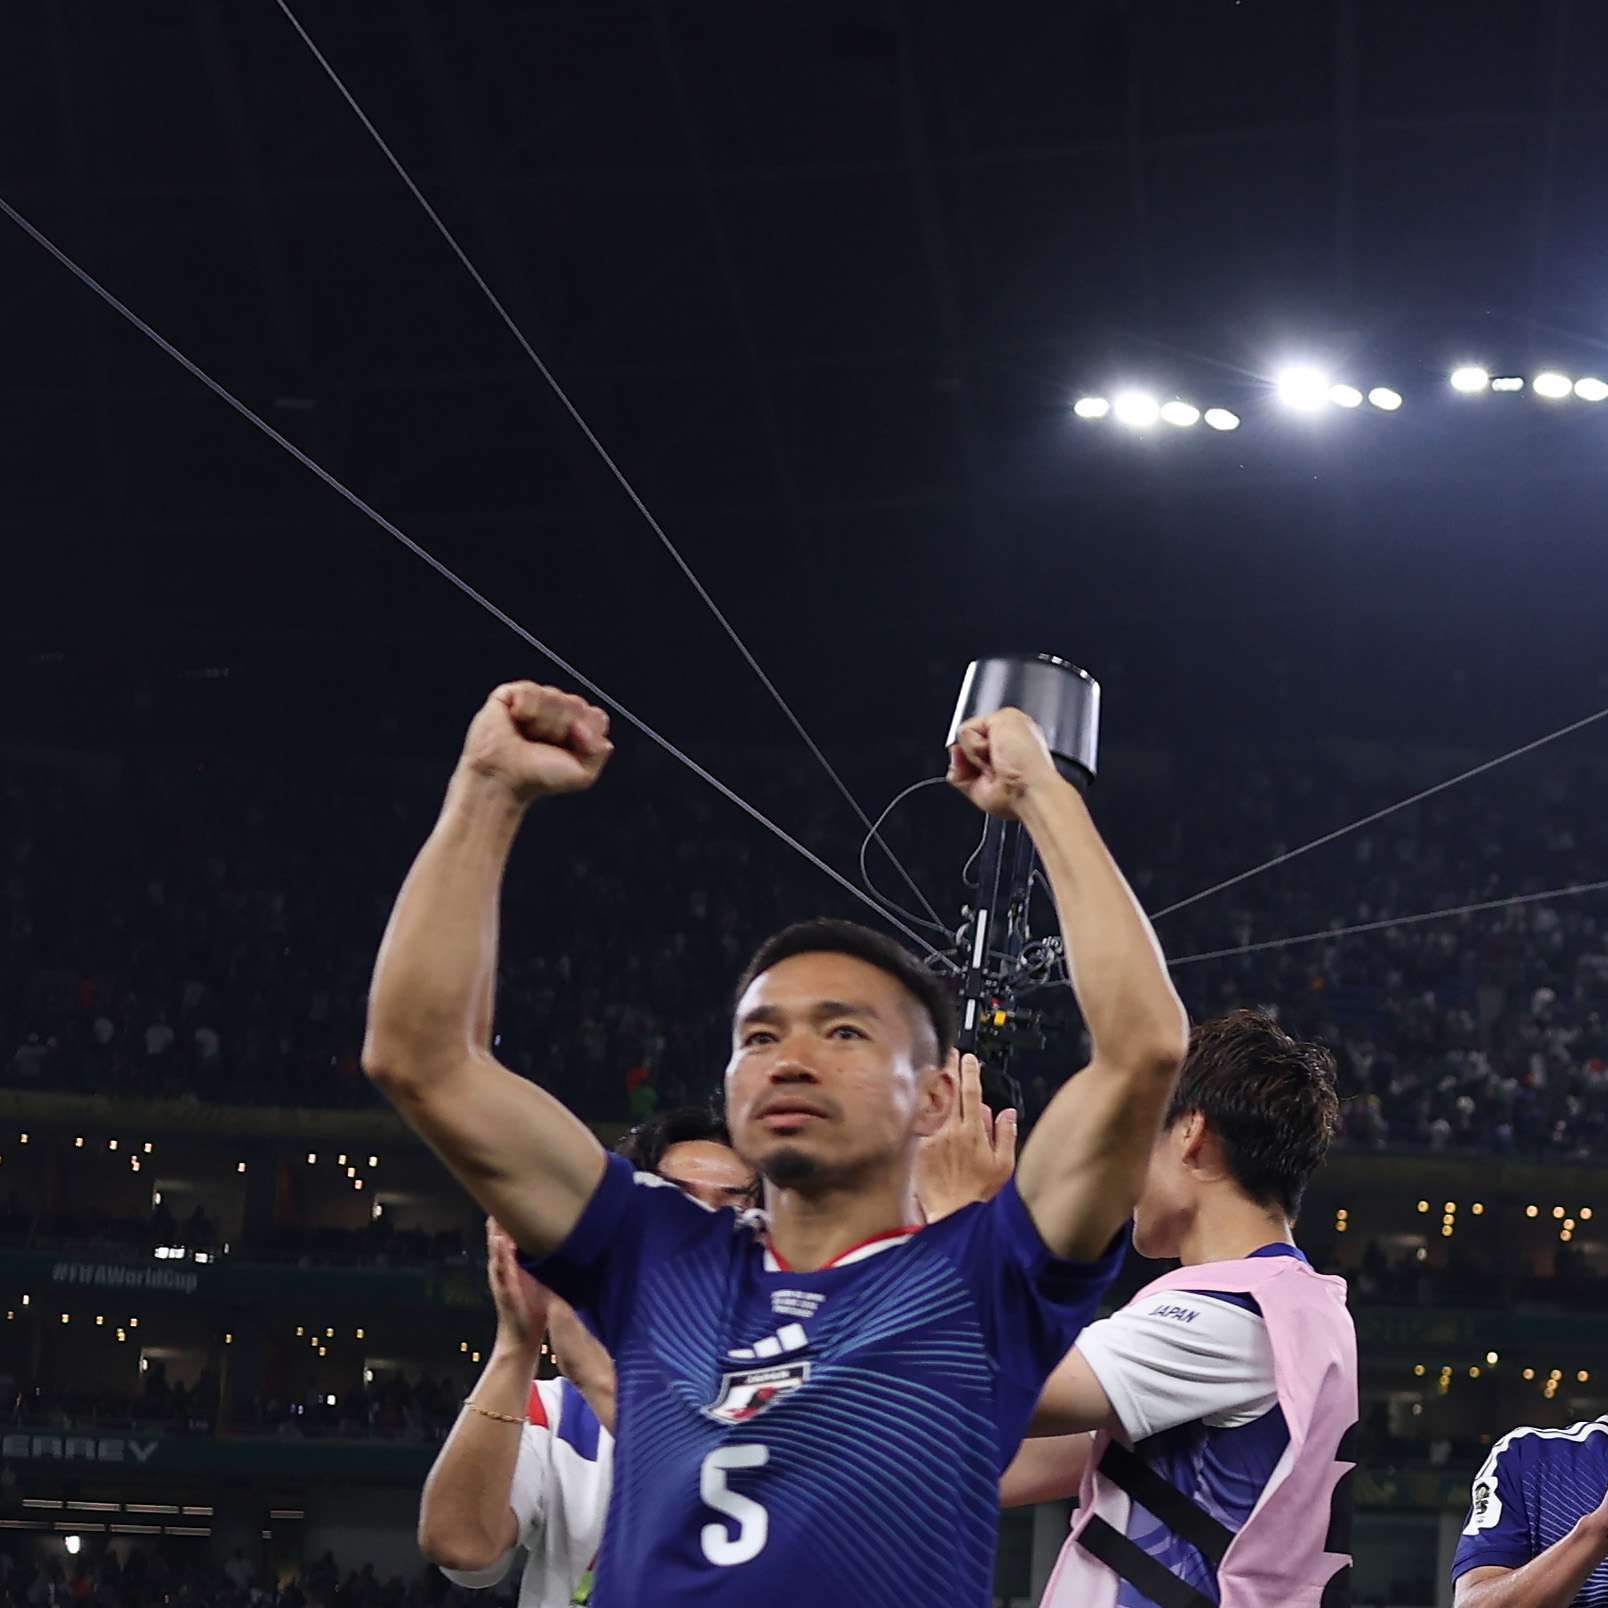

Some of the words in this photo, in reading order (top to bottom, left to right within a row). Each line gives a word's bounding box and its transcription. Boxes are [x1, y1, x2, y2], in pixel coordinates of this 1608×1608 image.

[52, 1263, 198, 1294] #FIFAWorldCup
[1148, 1305, 1201, 1323] JAPAN
[700, 1443, 769, 1566] 5
